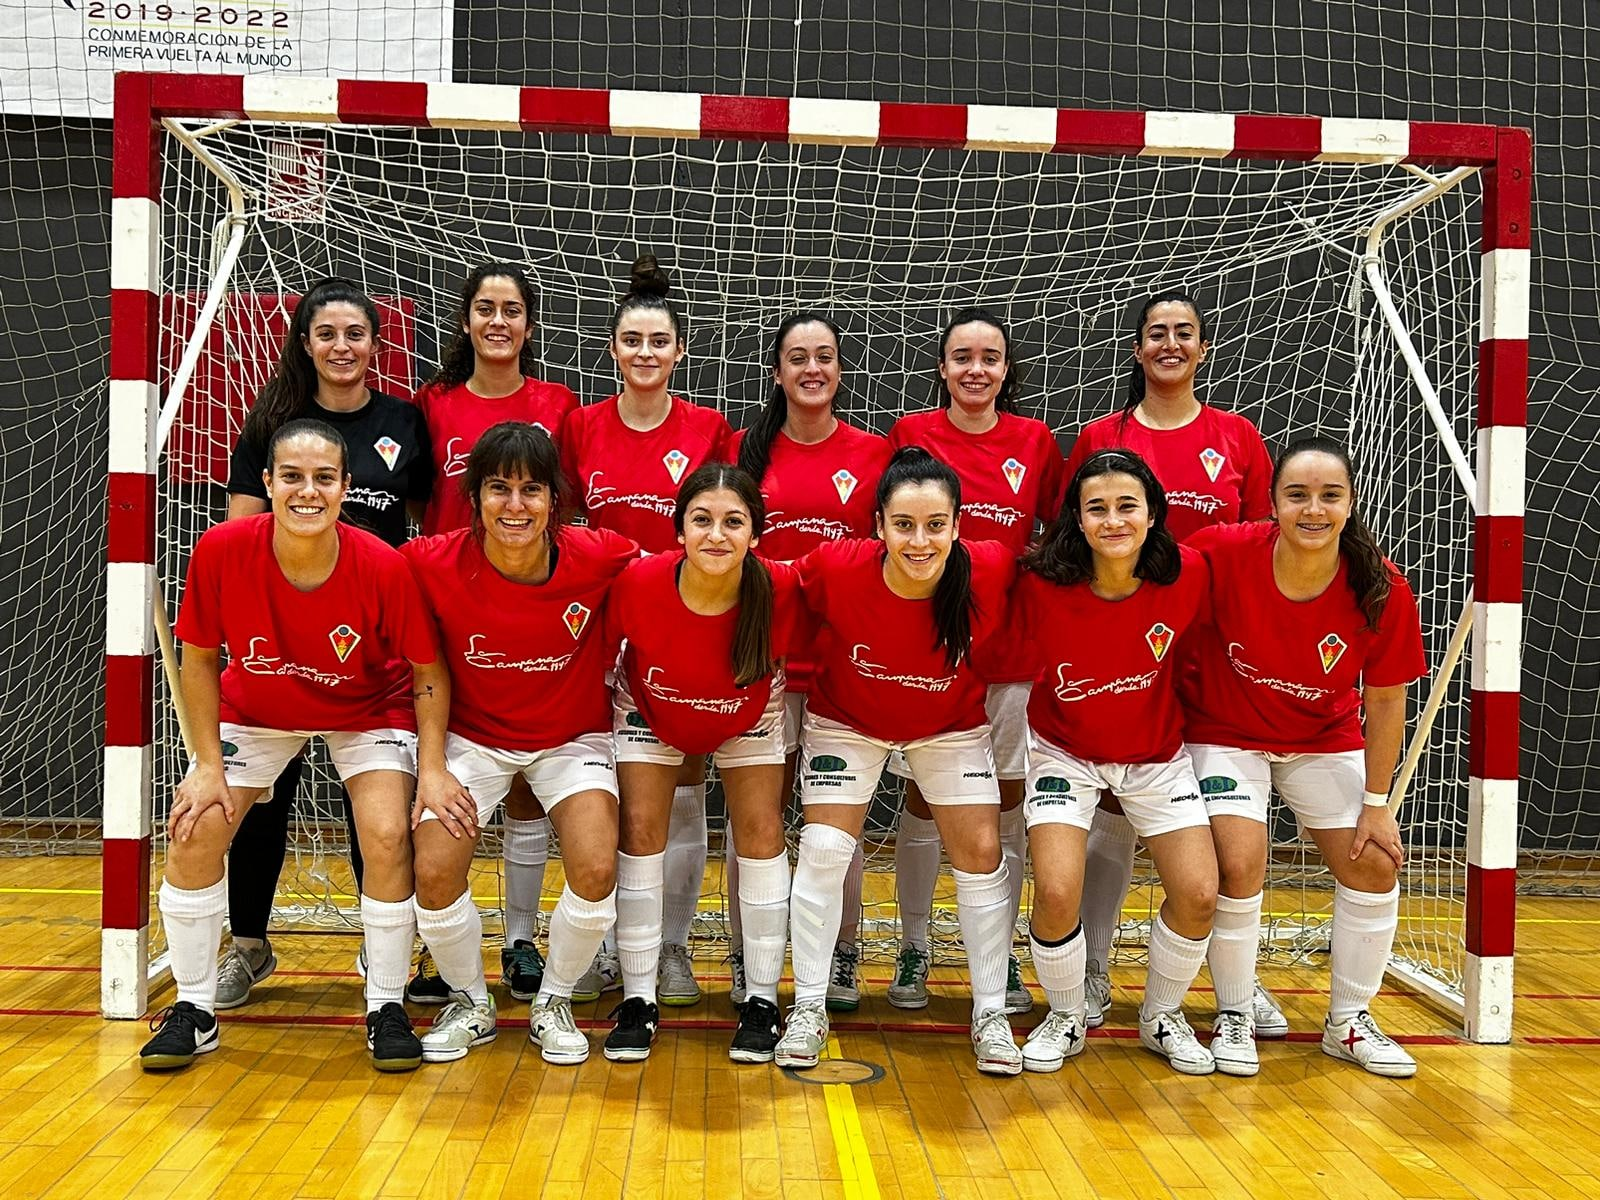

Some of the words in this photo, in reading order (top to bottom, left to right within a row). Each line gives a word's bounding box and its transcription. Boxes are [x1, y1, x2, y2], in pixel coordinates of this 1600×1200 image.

[88, 28, 239, 47] CONMEMORACION
[245, 36, 266, 50] DE
[273, 38, 293, 51] LA
[88, 45, 153, 60] PRIMERA
[156, 48, 213, 63] VUELTA
[215, 51, 233, 65] AL
[236, 52, 292, 68] MUNDO
[655, 502, 676, 518] 1947
[1194, 499, 1218, 515] 1947
[995, 511, 1017, 527] 1947
[823, 526, 845, 540] 1947
